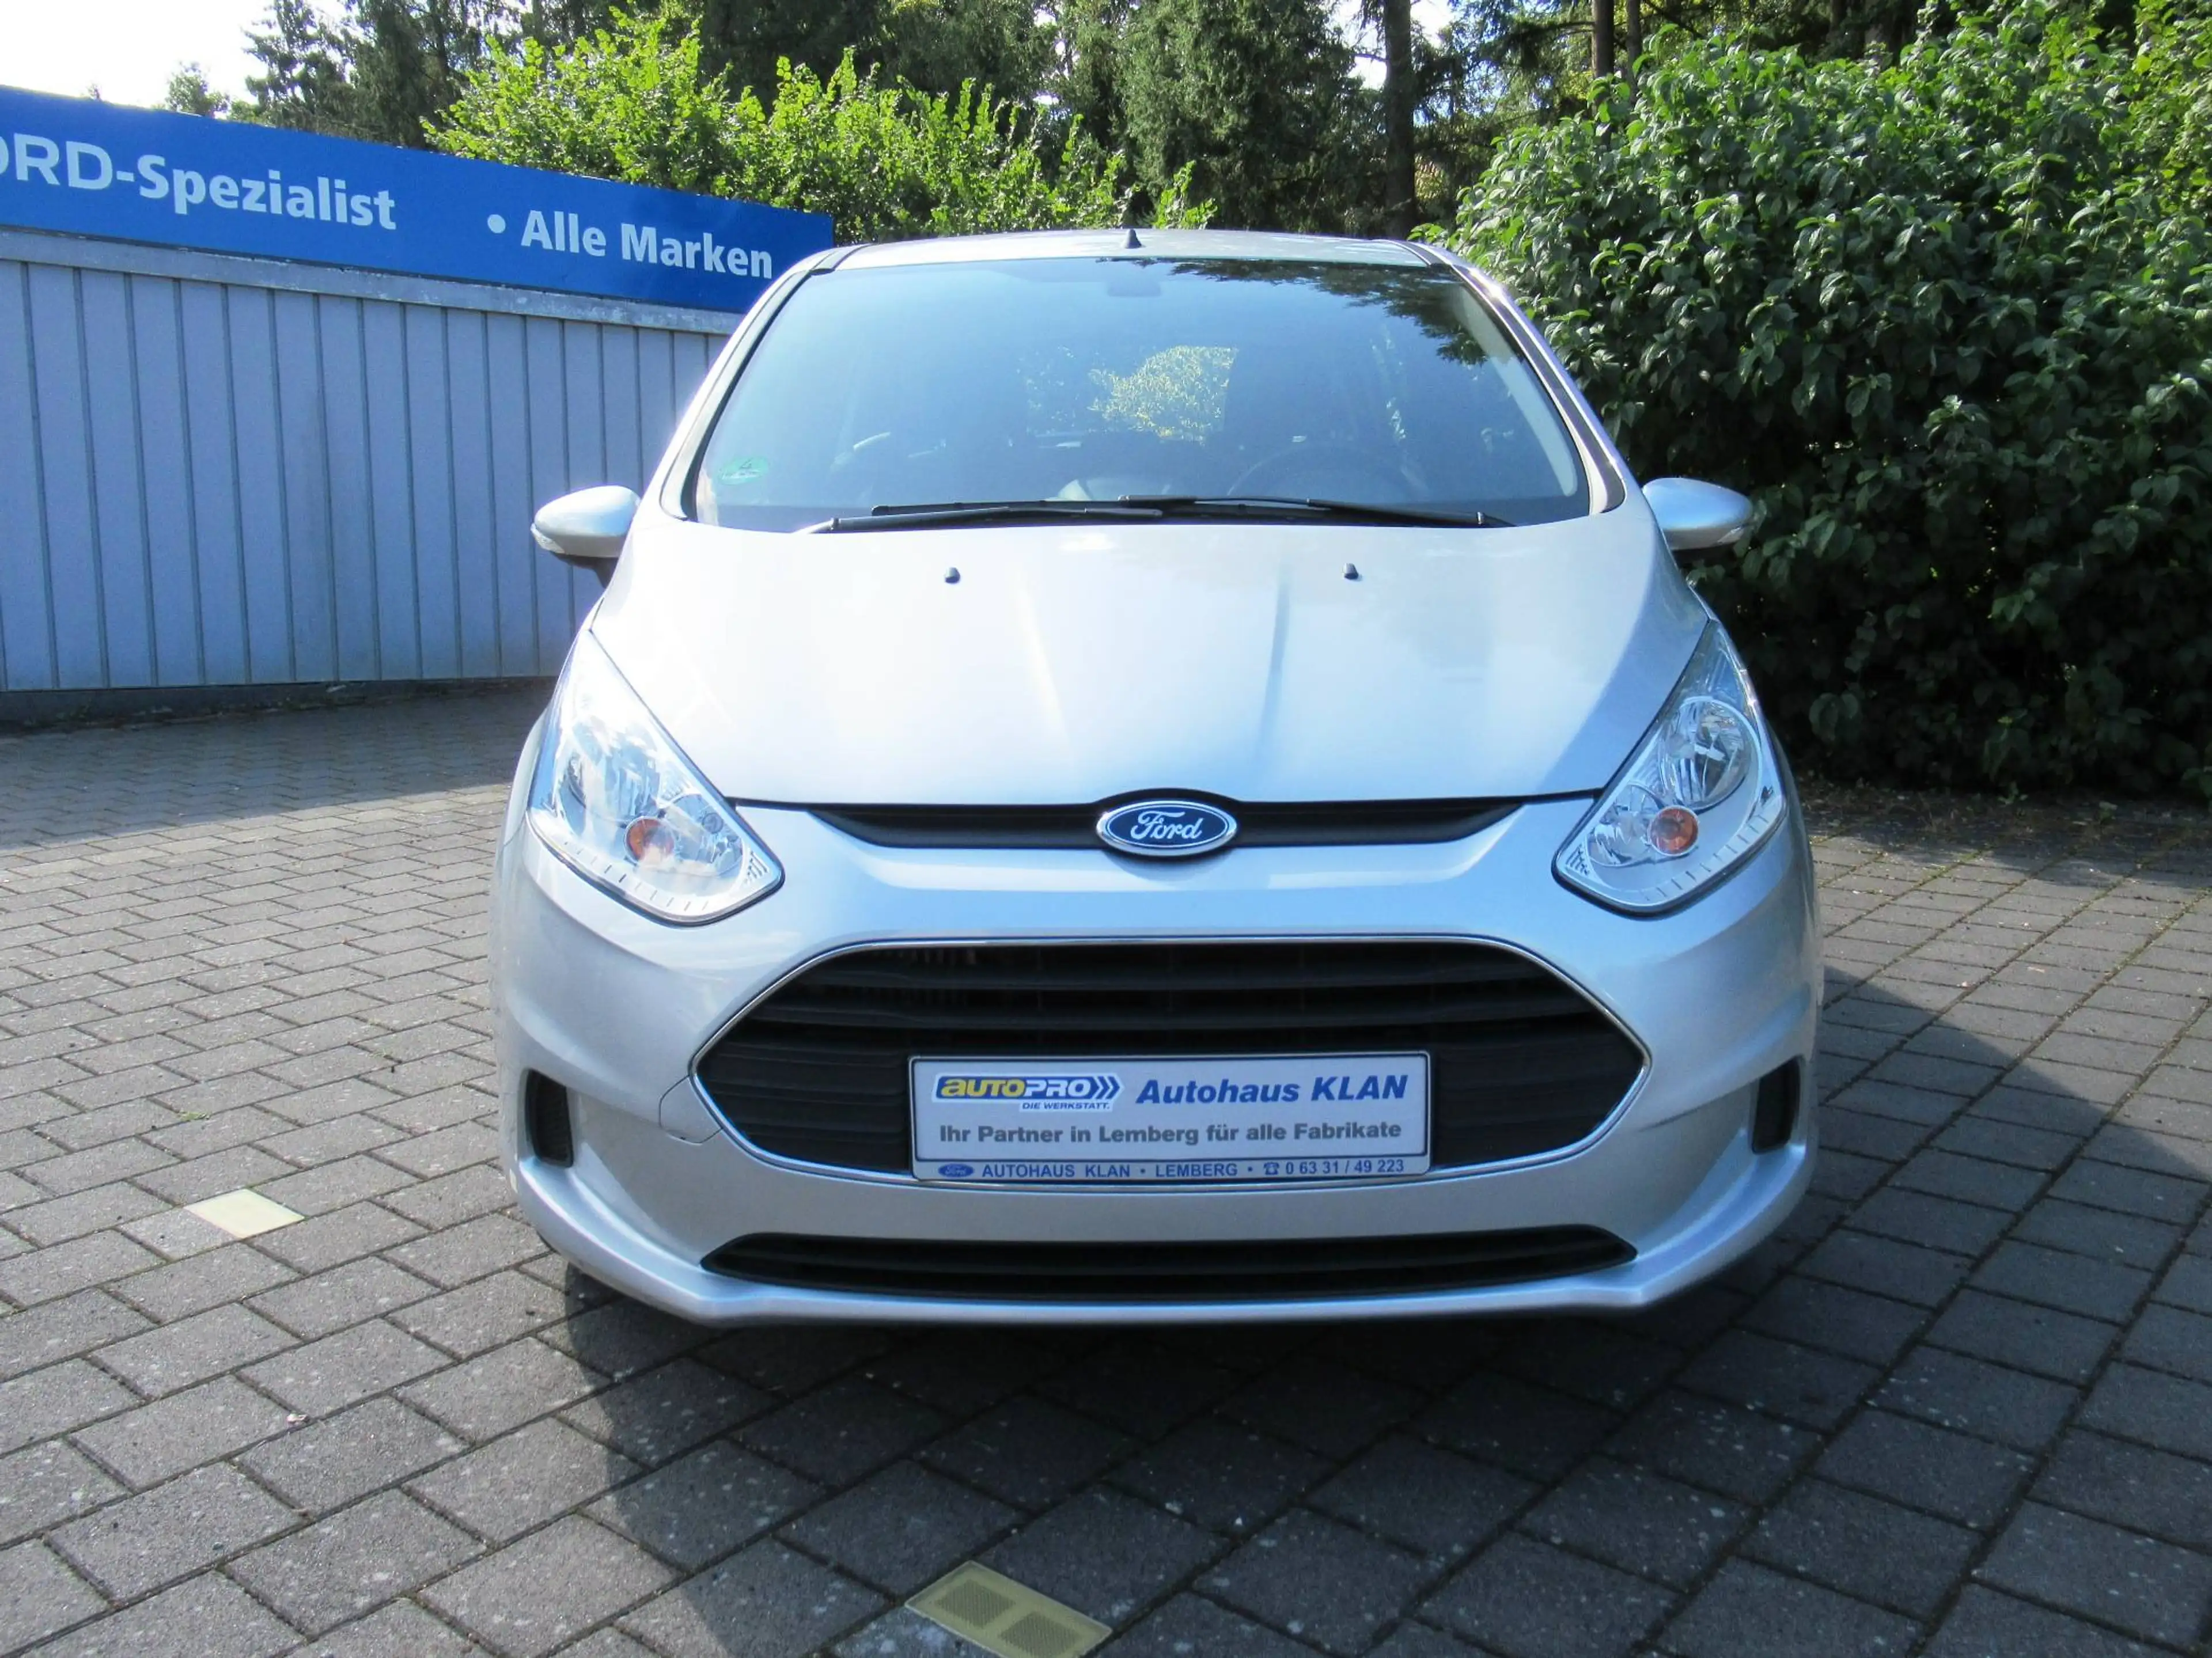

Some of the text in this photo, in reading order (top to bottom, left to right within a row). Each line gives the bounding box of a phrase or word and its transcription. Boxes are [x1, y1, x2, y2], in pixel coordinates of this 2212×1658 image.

[0, 133, 396, 230] RD-Spezialist
[521, 210, 772, 279] Alle Marken
[1130, 810, 1204, 839] Ford
[1136, 1074, 1408, 1104] Autohaus KLAN
[1022, 1102, 1040, 1110] DIE
[940, 1121, 1402, 1146] Ihr Partner in Lemberg für alle Fabrikate
[981, 1164, 1075, 1178] AUTOHAUS
[1085, 1164, 1130, 1178] KLAN
[1156, 1163, 1238, 1178] LEMBERG
